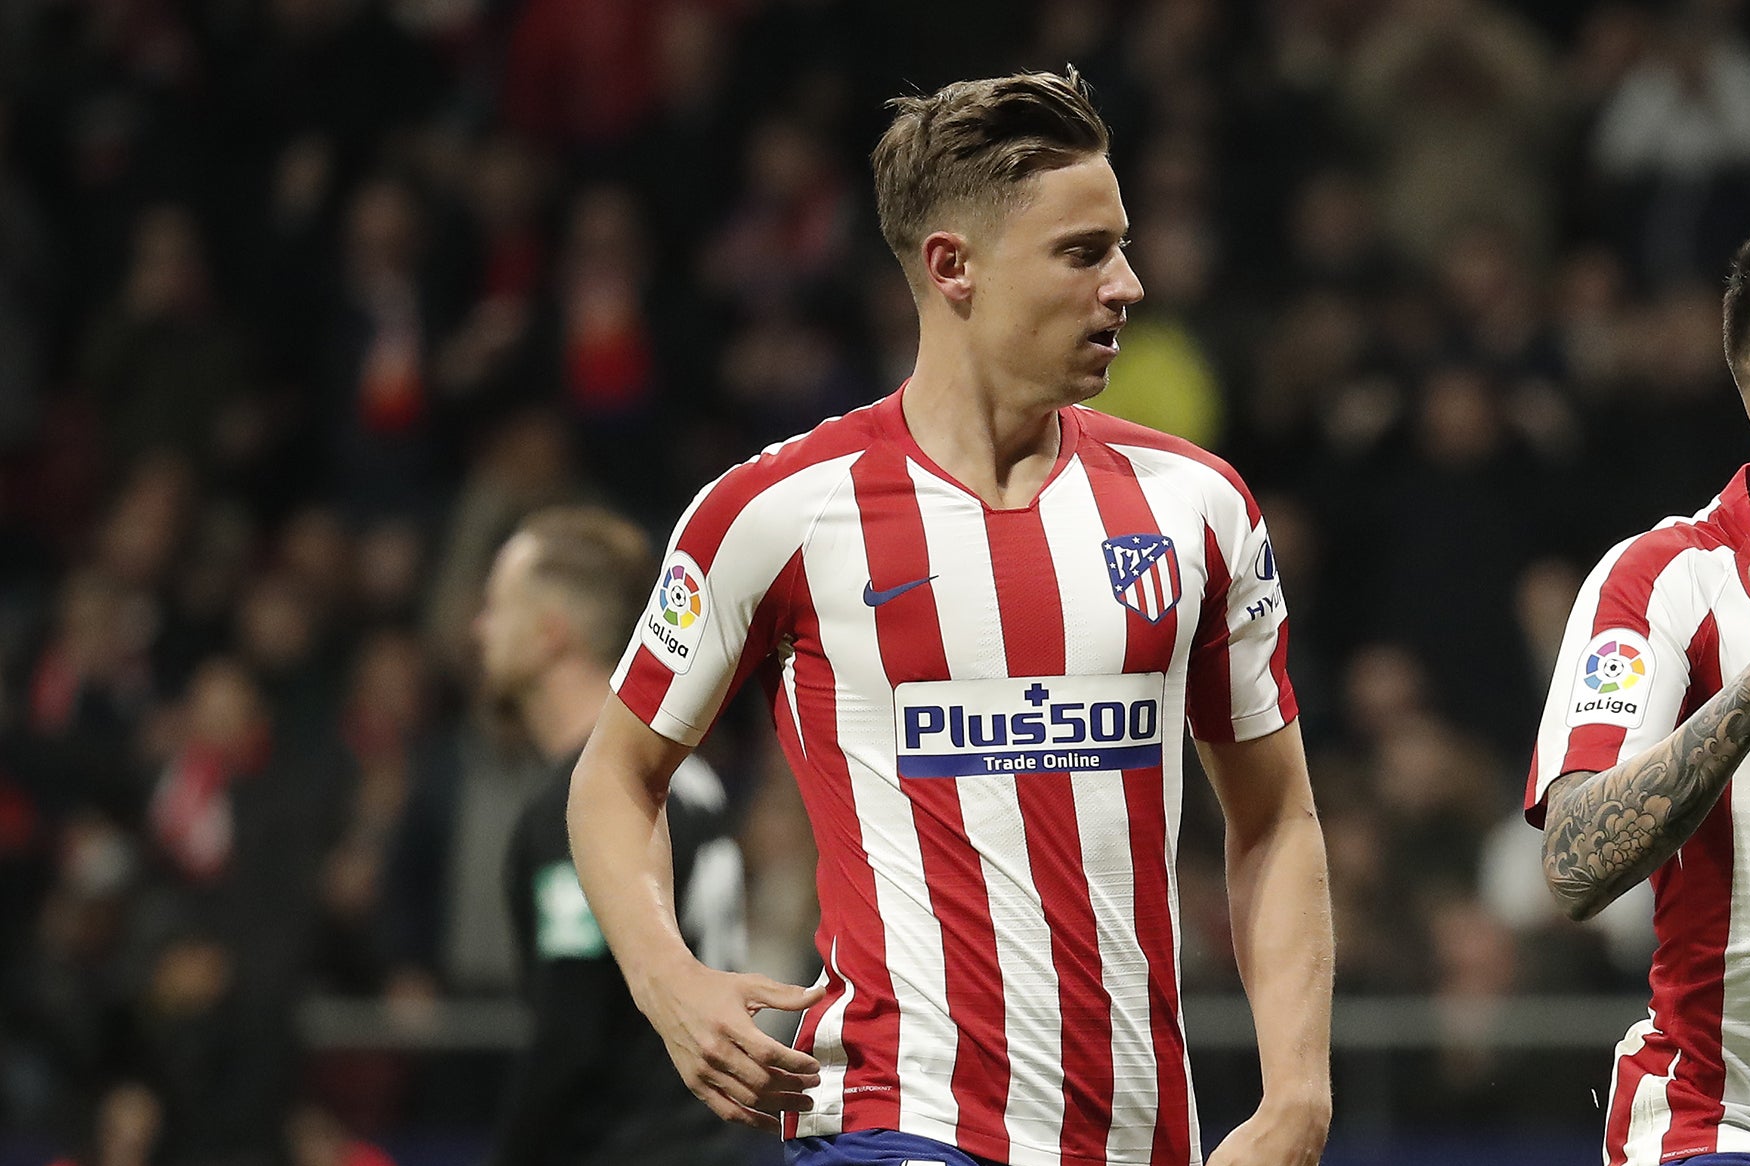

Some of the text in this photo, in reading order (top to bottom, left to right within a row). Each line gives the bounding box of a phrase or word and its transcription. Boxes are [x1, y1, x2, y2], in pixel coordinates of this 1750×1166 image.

[648, 613, 690, 659] LaLiga
[1575, 696, 1638, 715] LaLiga
[903, 699, 1158, 750] Plus500
[983, 753, 1100, 772] Trade Online
